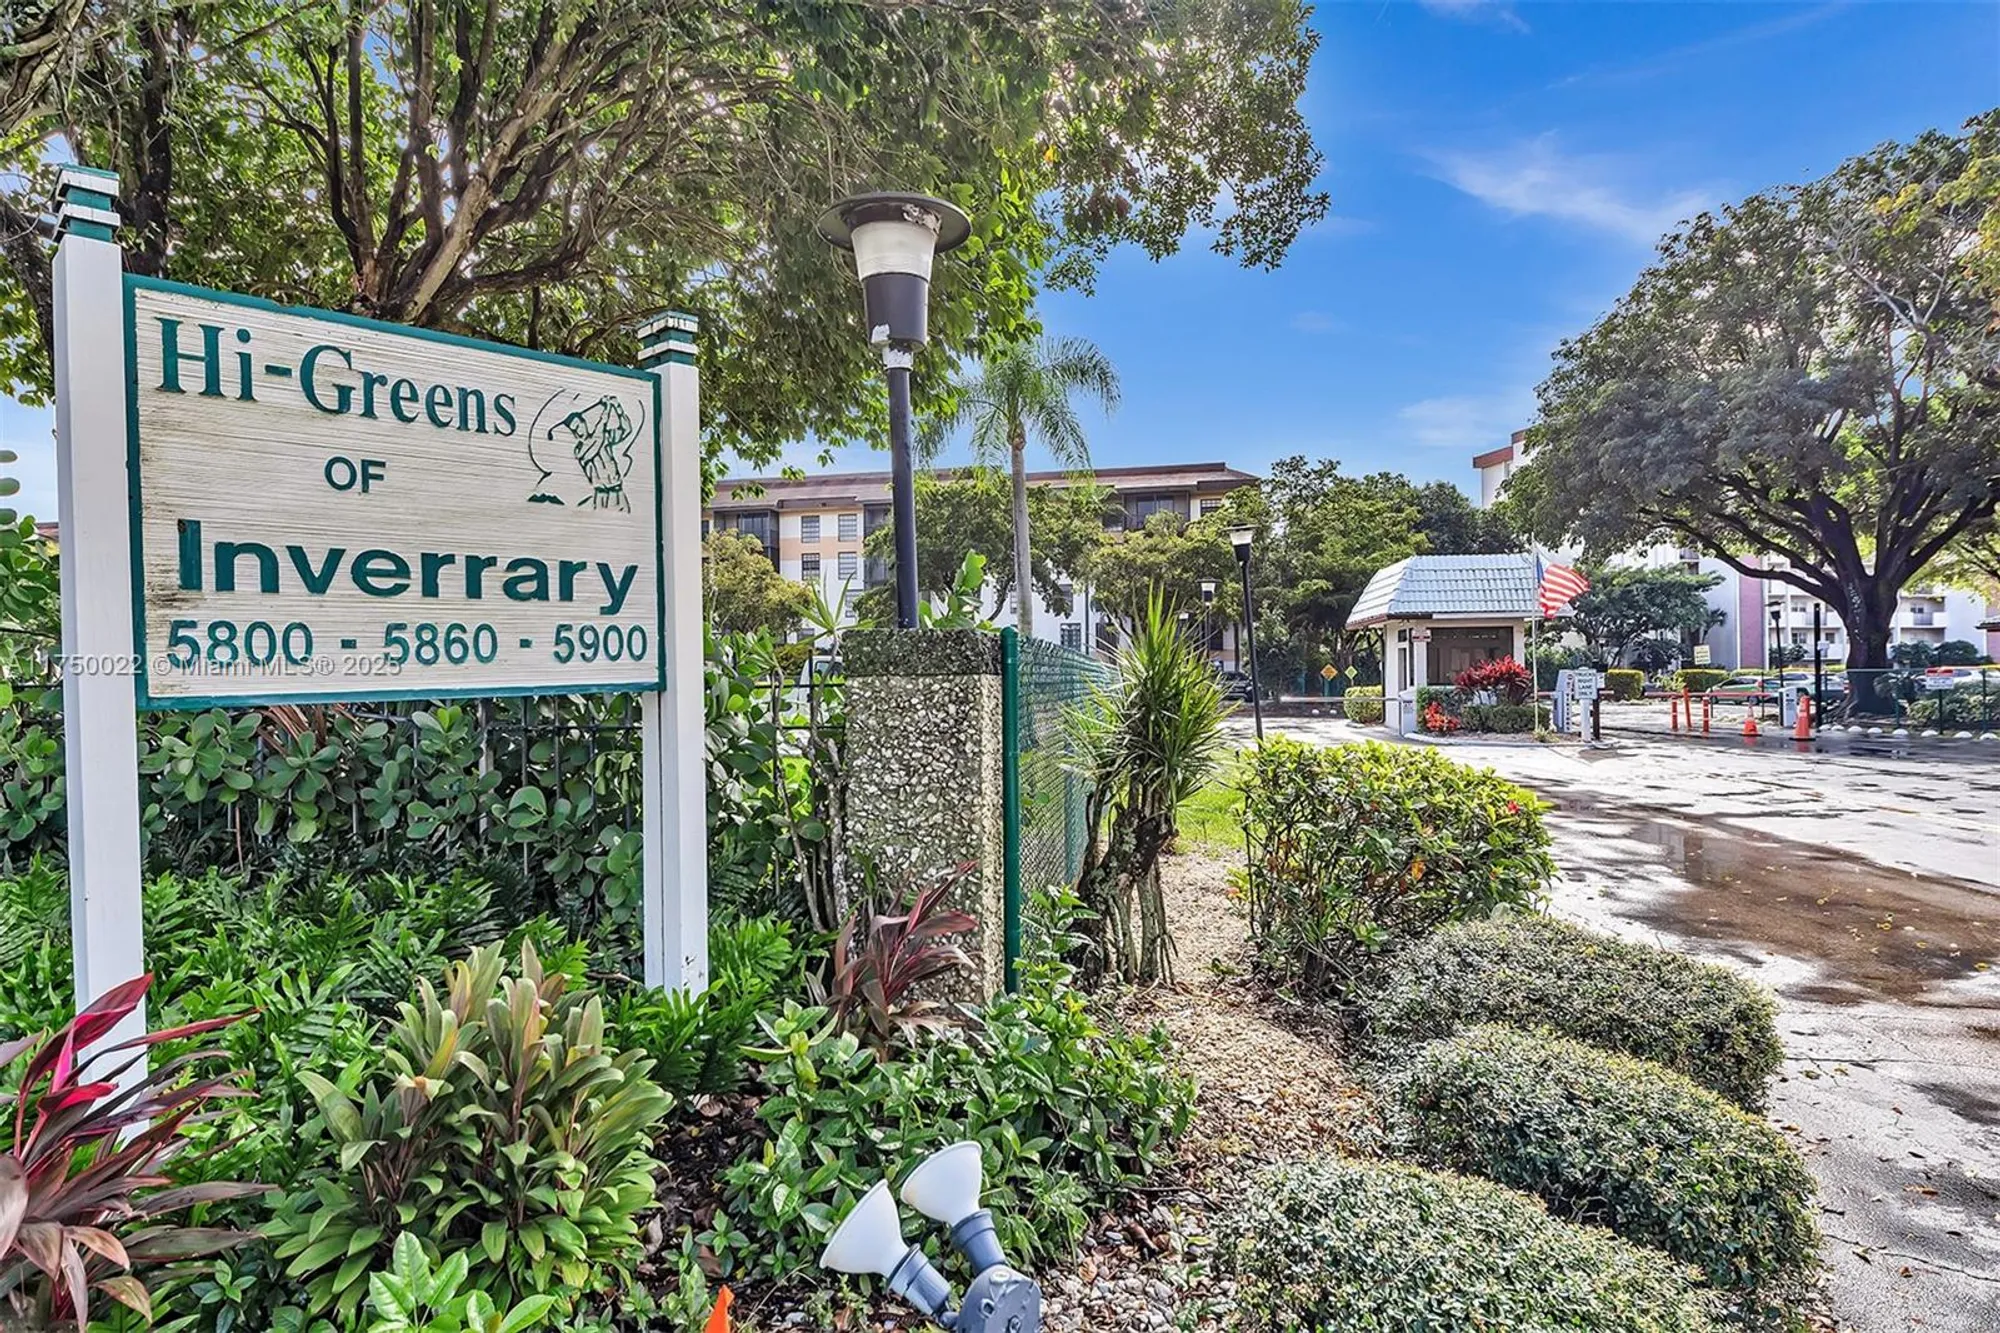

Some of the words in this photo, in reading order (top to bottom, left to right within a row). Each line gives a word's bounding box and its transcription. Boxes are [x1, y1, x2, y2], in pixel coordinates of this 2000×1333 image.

[156, 316, 517, 437] Hi-Greens
[324, 455, 386, 493] OF
[178, 518, 639, 616] Inverrary
[167, 619, 314, 669] 5800
[340, 638, 358, 650] -
[383, 621, 499, 667] 5860
[519, 638, 533, 649] -
[553, 623, 648, 664] 5900
